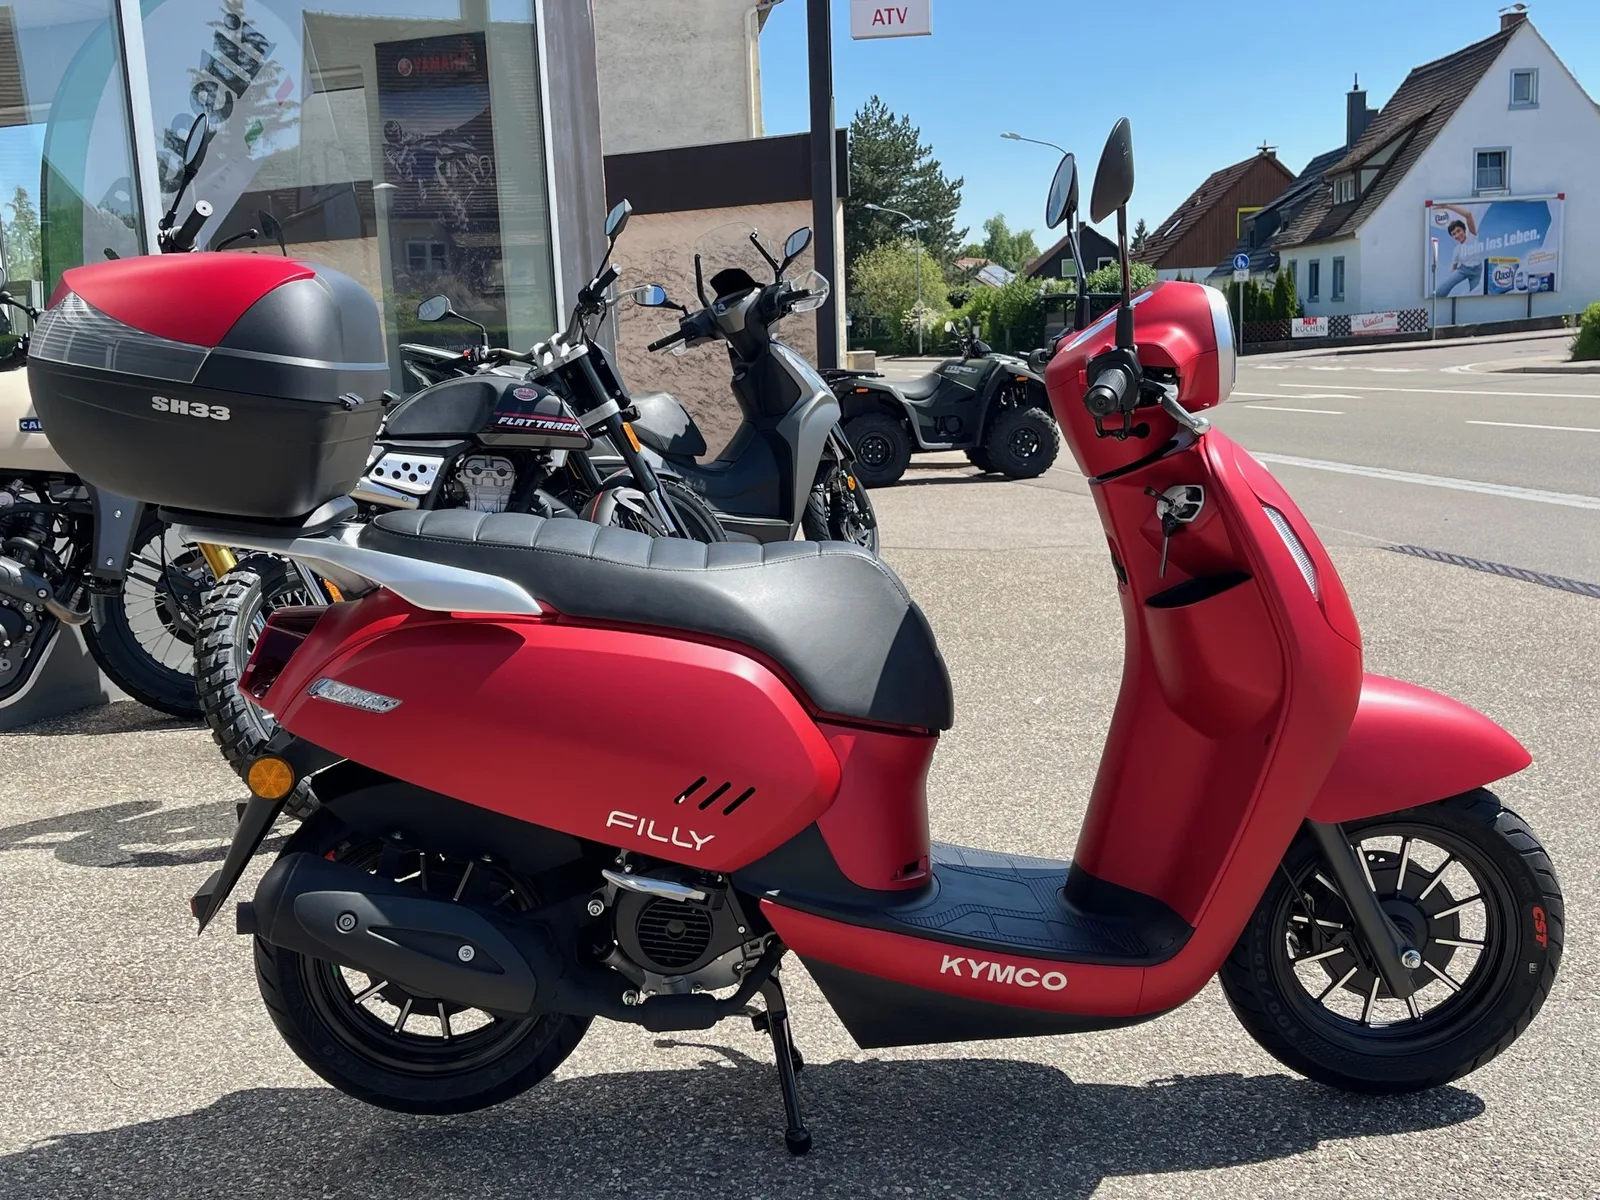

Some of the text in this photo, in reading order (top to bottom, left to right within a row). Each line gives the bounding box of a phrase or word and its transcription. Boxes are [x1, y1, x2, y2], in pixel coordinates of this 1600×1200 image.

[872, 7, 908, 26] ATV
[412, 53, 476, 74] YAMAHA
[1486, 237, 1502, 251] ins
[1504, 228, 1541, 247] Leben.
[1495, 266, 1514, 281] Dash
[152, 396, 231, 421] SH33
[606, 810, 716, 852] FILLY
[1532, 906, 1548, 949] CST
[940, 954, 1067, 991] KYMCO
